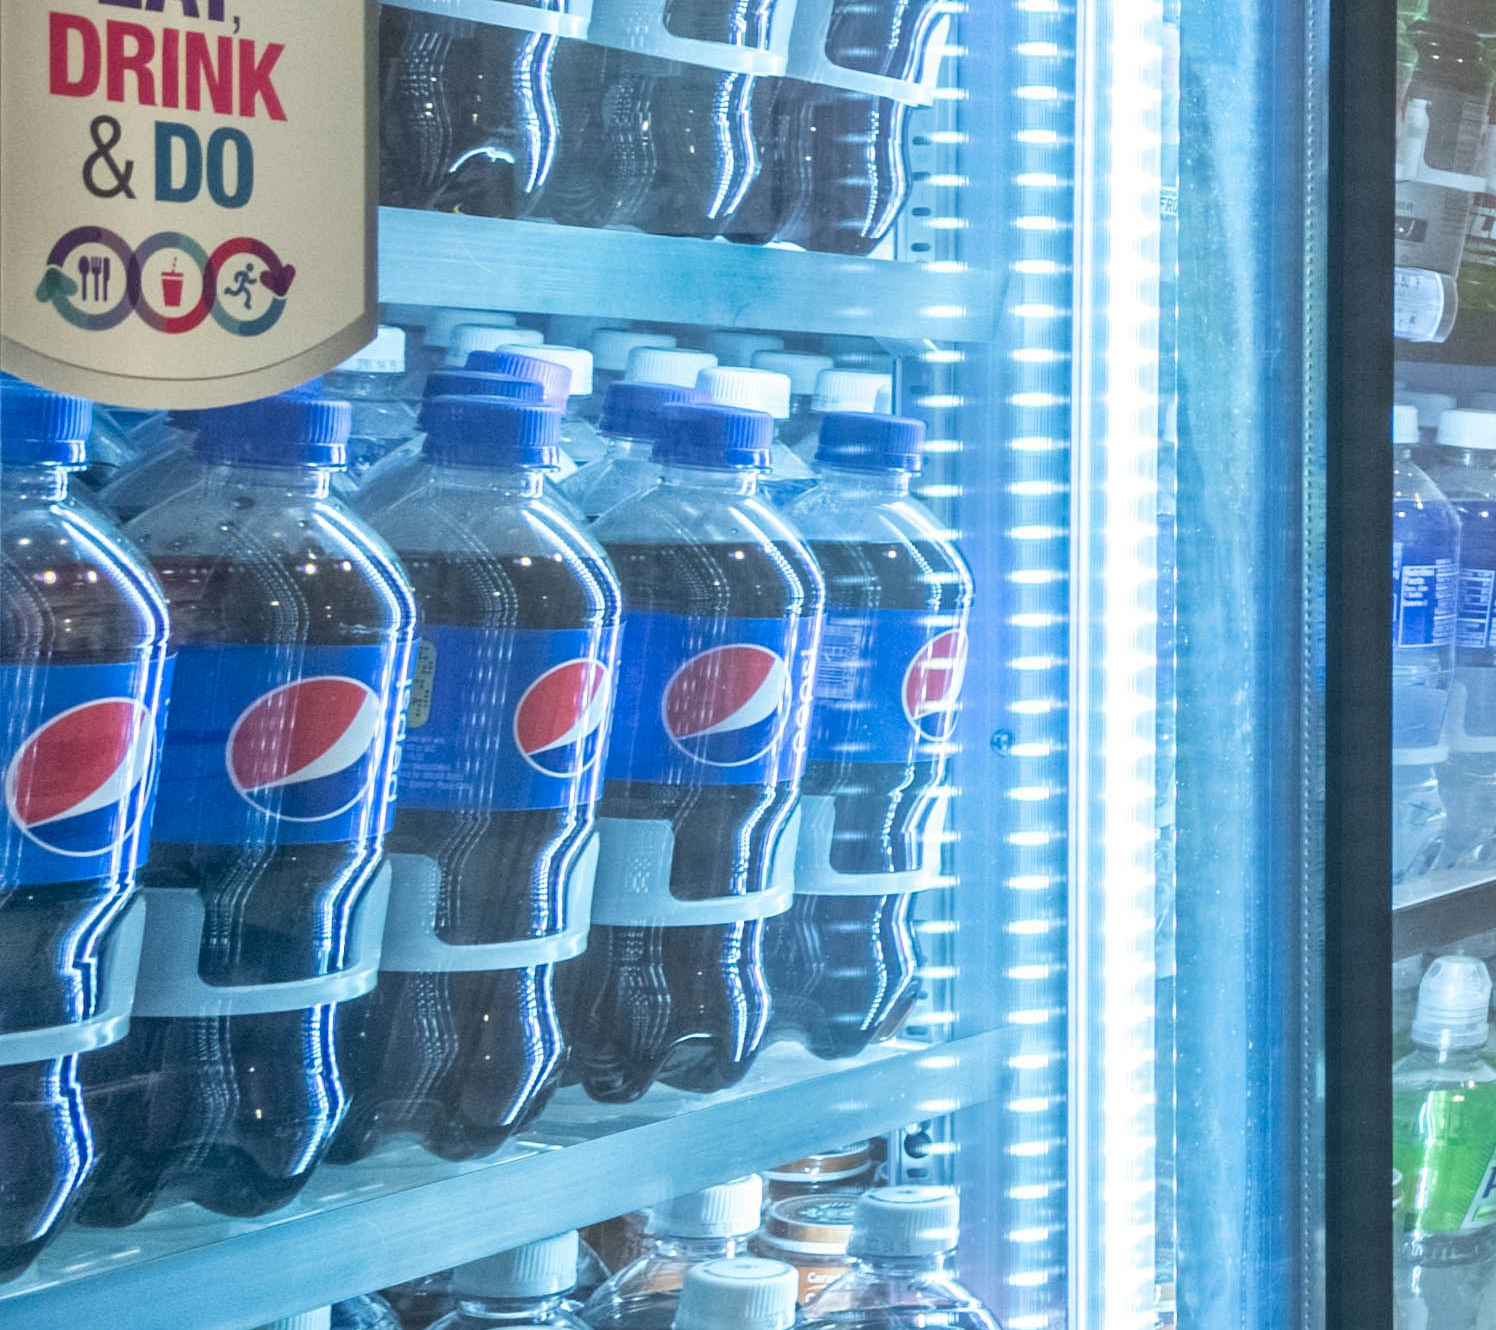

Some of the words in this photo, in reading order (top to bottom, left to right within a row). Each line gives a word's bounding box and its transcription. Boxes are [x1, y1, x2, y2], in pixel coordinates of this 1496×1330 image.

[48, 10, 289, 122] DRINK
[81, 114, 137, 200] &
[154, 119, 255, 209] DO
